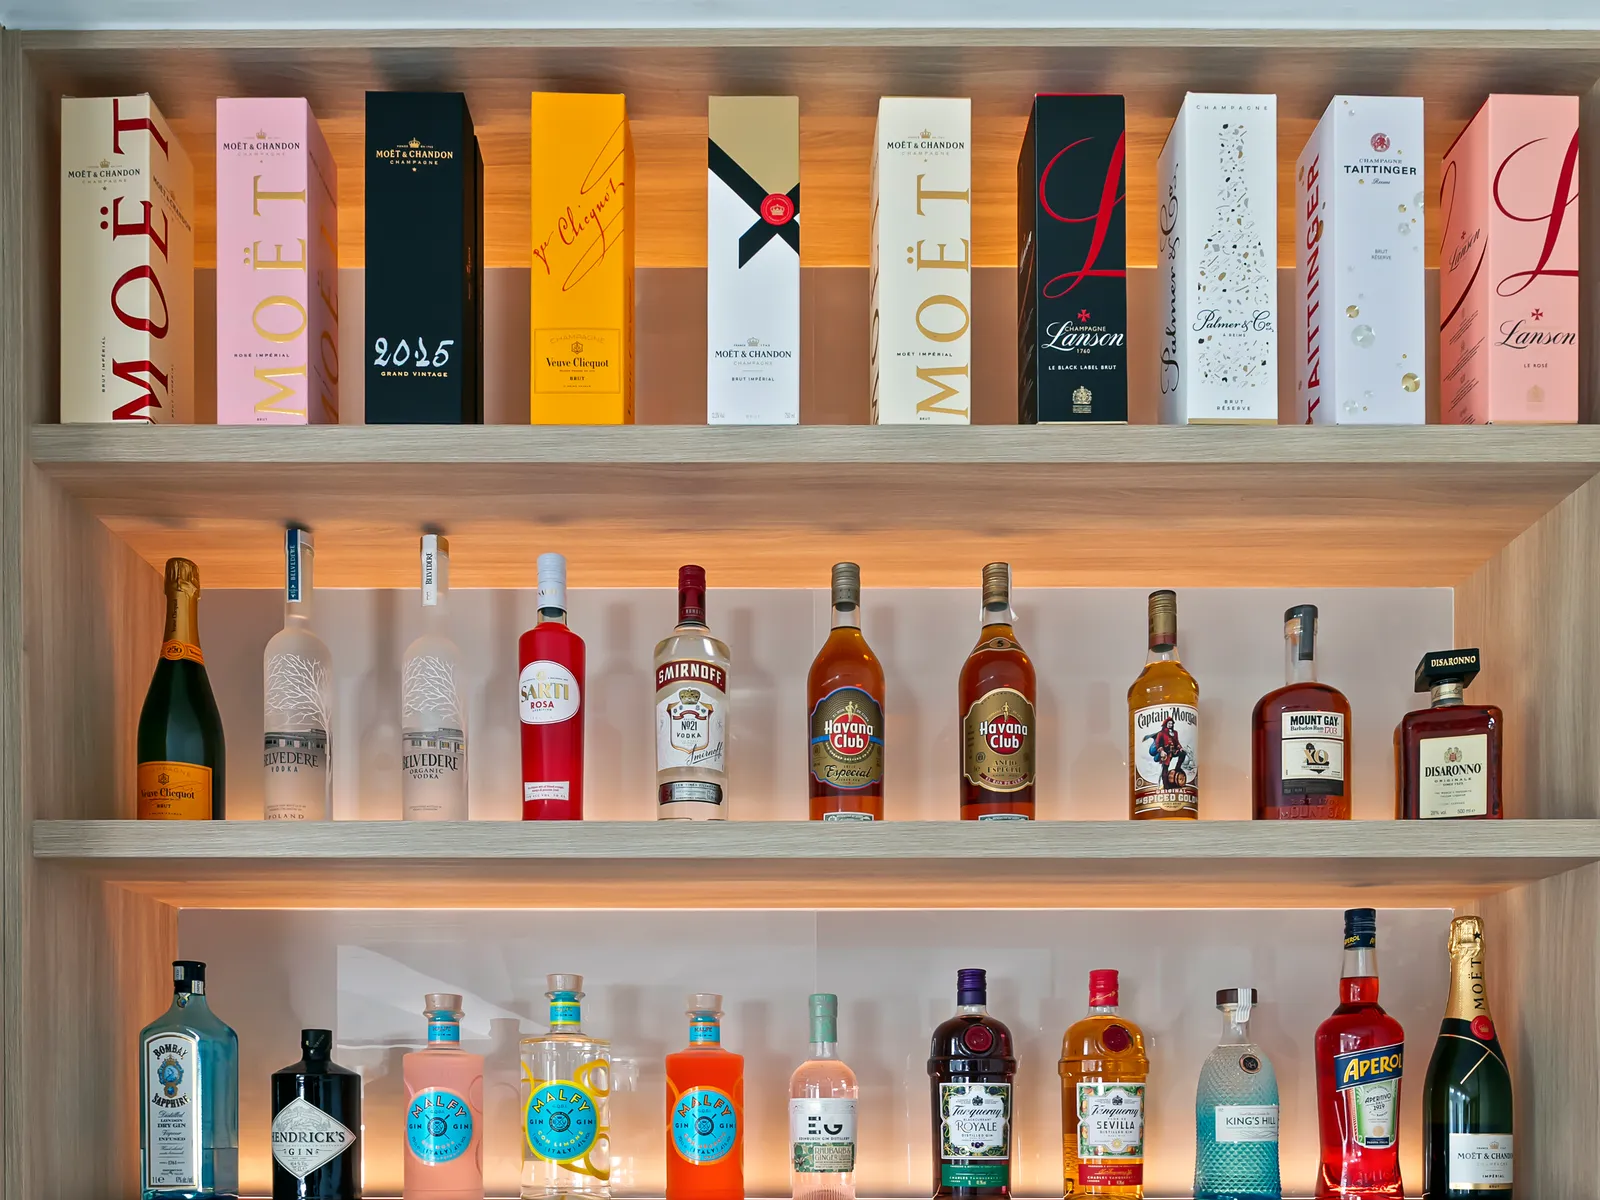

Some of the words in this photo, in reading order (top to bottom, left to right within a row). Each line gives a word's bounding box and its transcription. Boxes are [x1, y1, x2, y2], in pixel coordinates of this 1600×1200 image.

[223, 142, 247, 150] MOËT
[256, 142, 300, 150] CHANDON
[887, 141, 912, 149] MOËT
[921, 141, 965, 149] CHANDON
[376, 150, 401, 159] MOËT
[409, 150, 453, 159] CHANDON
[68, 170, 92, 179] MOËT
[100, 169, 140, 178] CHANDON
[1344, 165, 1416, 175] TAITTINGER
[100, 98, 169, 425] MOËT
[244, 174, 307, 418] MOËT
[1307, 153, 1320, 424] TAITTINGER
[907, 174, 970, 419] MOËT
[1193, 309, 1240, 332] Palmer
[1240, 320, 1252, 332] &
[1041, 321, 1124, 352] Lanson
[1494, 320, 1576, 349] Lanson
[374, 337, 455, 367] 2015
[715, 350, 739, 358] MOËT
[749, 350, 791, 358] CHANDON
[546, 358, 571, 367] Veuve
[573, 357, 609, 369] Clicquot
[997, 640, 1004, 648] 5
[1431, 655, 1477, 668] DISARONNO
[521, 682, 569, 702] SARTI
[530, 701, 555, 709] ROSA
[1138, 709, 1169, 729] Captain
[1171, 707, 1197, 726] Morgan
[1290, 716, 1322, 726] MOUNT
[1324, 716, 1339, 727] GAY
[824, 720, 874, 736] Havana
[980, 721, 1028, 736] Havana
[834, 735, 864, 748] Club
[990, 735, 1020, 748] Club
[685, 742, 724, 766] Smirnoff
[1303, 749, 1329, 764] XO
[410, 766, 444, 774] ORGANIC
[824, 765, 872, 780] Especial
[1425, 763, 1482, 778] DISARONNO
[160, 788, 195, 799] Clicquot
[1142, 794, 1176, 805] SPICED
[1178, 794, 1197, 804] GOLD
[1467, 957, 1486, 1010] MOËT
[153, 1043, 188, 1060] BOMBAY
[1343, 1053, 1402, 1083] APEROL
[533, 1089, 591, 1114] MALFY
[1365, 1093, 1391, 1103] APERITIVO
[412, 1095, 467, 1118] MALFY
[678, 1094, 732, 1118] MALFY
[1091, 1104, 1139, 1118] Tanqueray
[158, 1110, 186, 1119] Distilled
[1226, 1116, 1260, 1126] KING'S
[955, 1119, 998, 1134] ROYALE
[1096, 1121, 1135, 1130] SEVILLA
[272, 1131, 345, 1142] HENDRICK'S
[538, 1130, 551, 1144] CON
[554, 1131, 584, 1147] LIMONE
